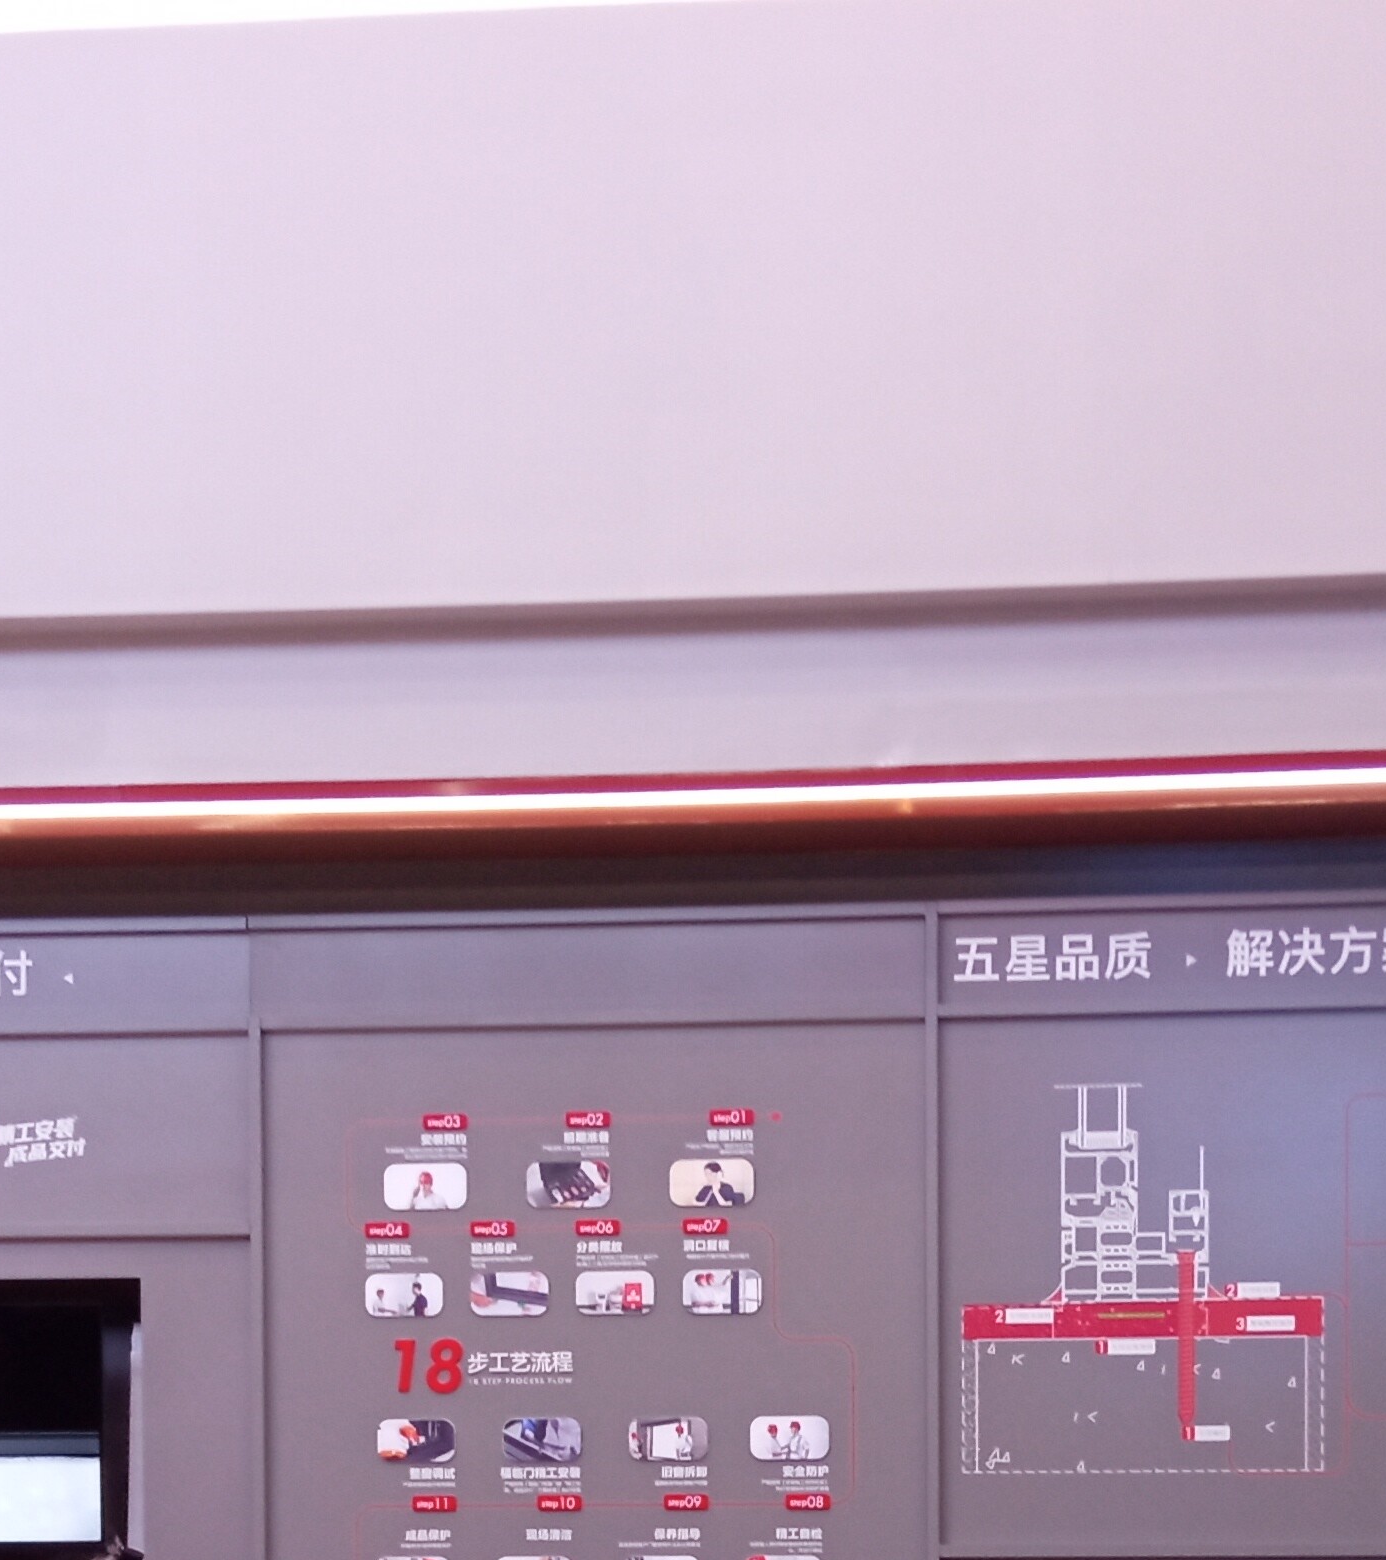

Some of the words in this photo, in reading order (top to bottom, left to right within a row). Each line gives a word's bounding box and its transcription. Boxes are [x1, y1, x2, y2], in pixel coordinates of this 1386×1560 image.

[953, 930, 1152, 983] 五星品质
[393, 1337, 464, 1394] 18
[467, 1351, 573, 1374] 步工艺流程
